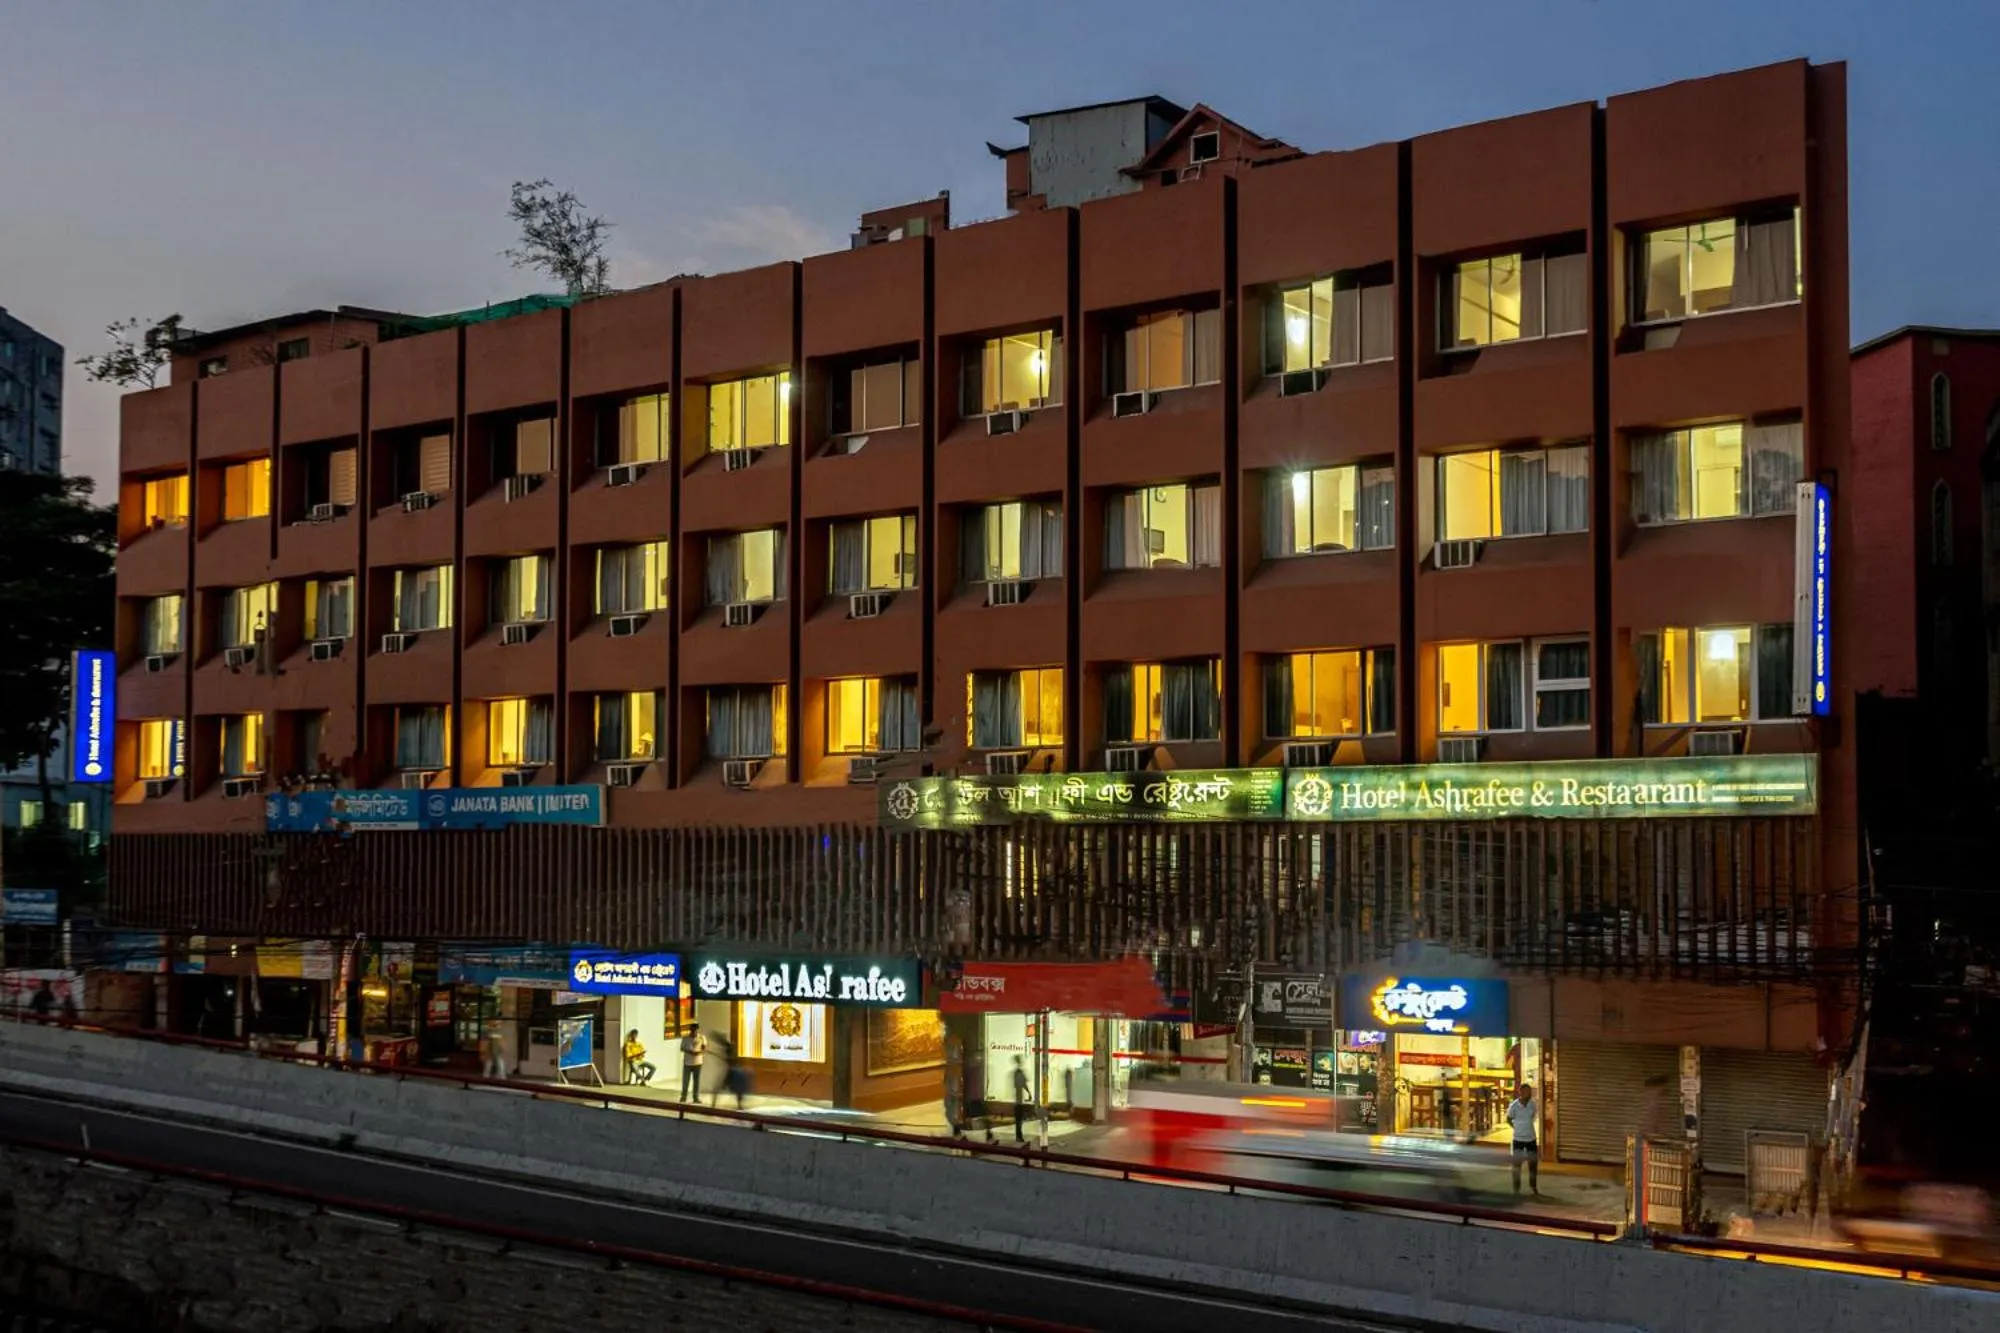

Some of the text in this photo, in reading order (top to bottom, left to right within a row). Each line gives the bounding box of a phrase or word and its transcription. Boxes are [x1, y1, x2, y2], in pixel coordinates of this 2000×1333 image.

[451, 796, 497, 812] JANATA
[500, 795, 535, 813] BANK
[1340, 780, 1406, 809] Hotel
[1415, 778, 1525, 812] Ashrafee
[1531, 780, 1553, 806] &
[726, 962, 790, 996] Hotel
